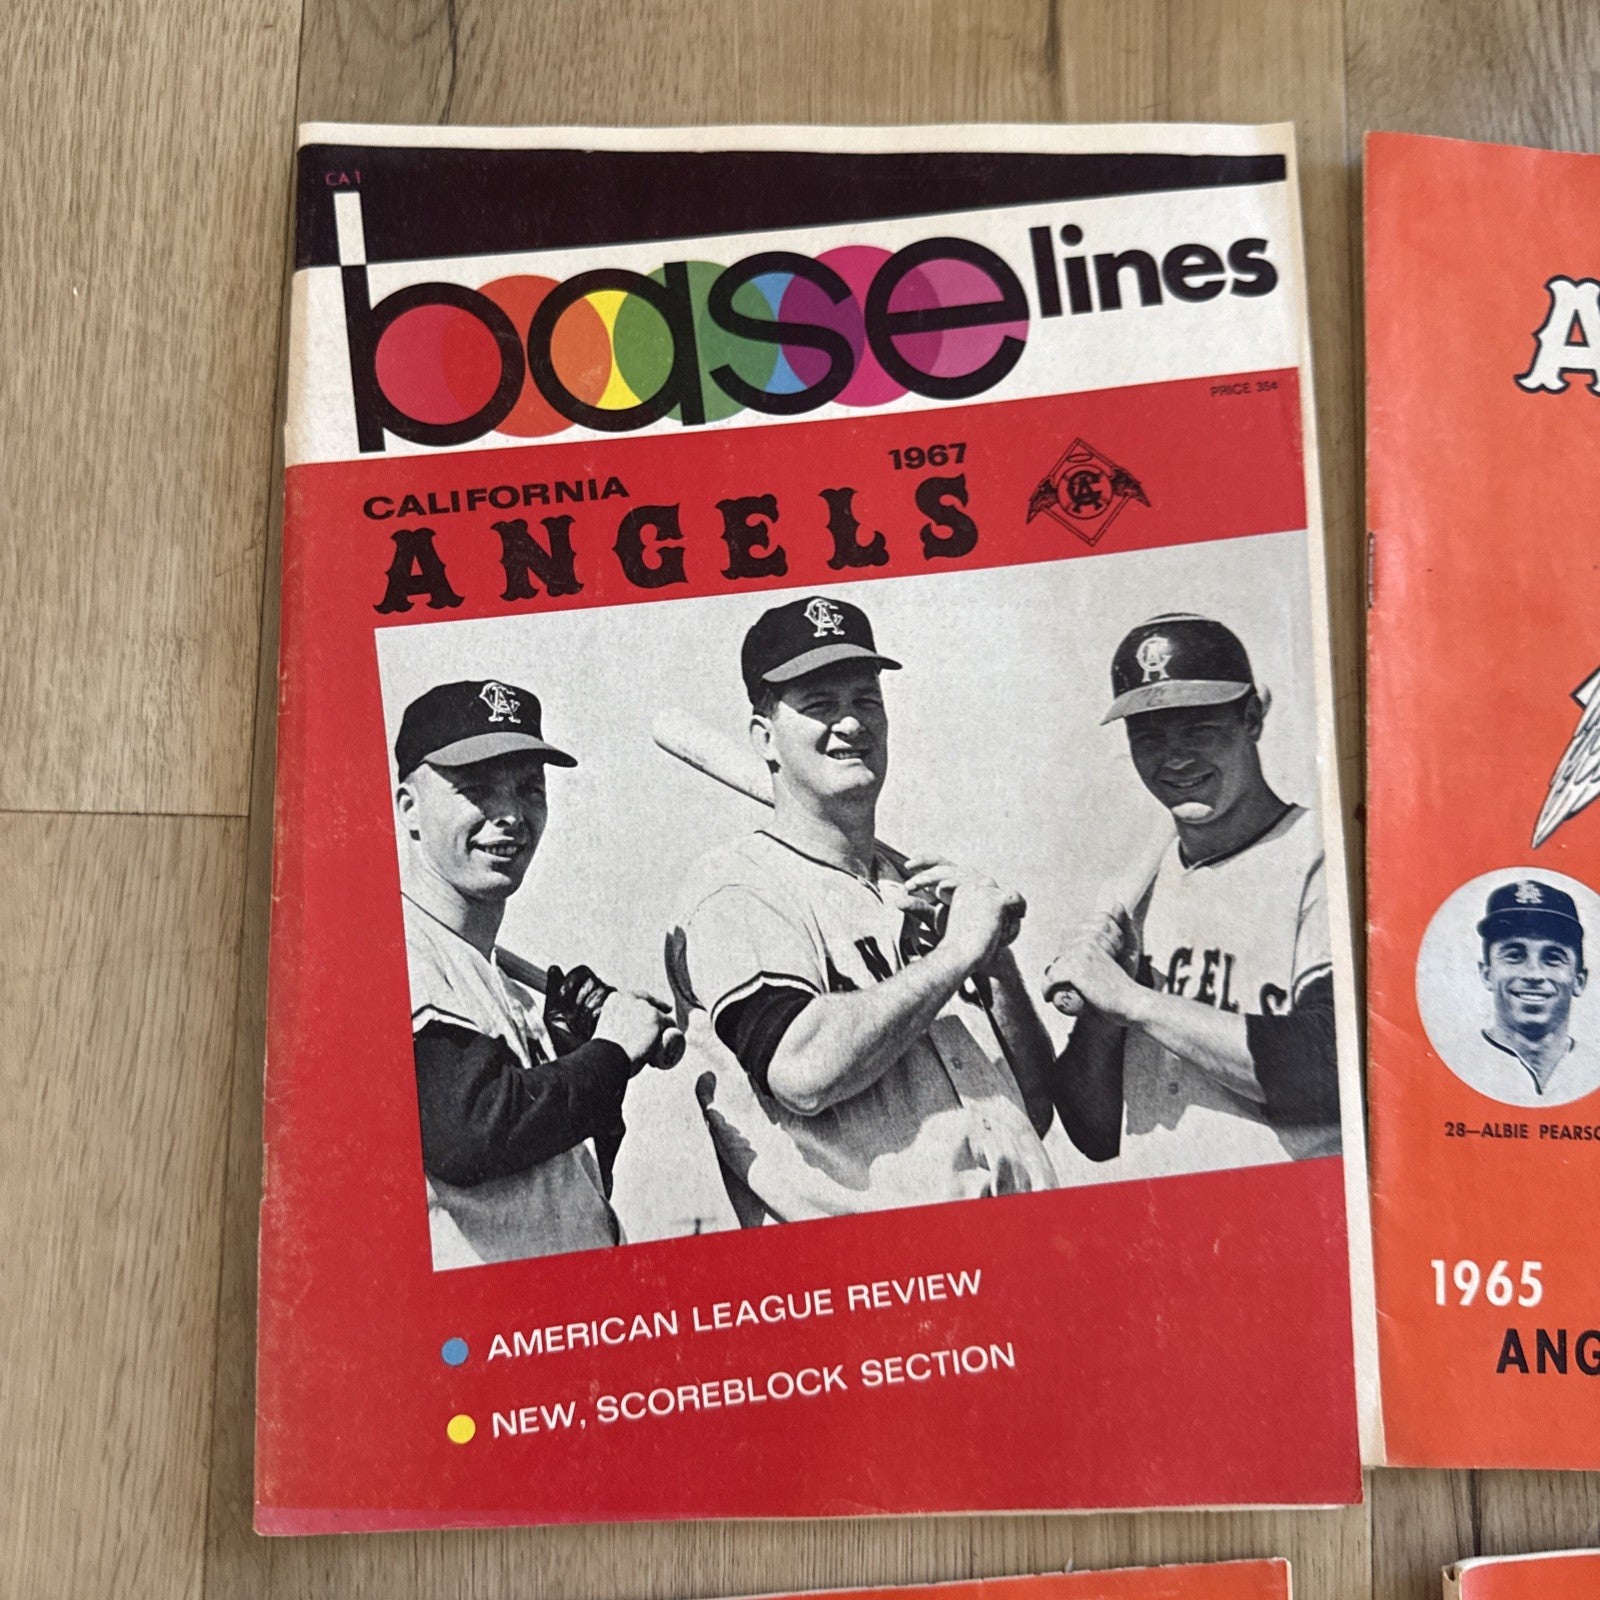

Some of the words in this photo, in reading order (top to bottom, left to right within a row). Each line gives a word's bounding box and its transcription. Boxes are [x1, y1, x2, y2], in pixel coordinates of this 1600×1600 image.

[324, 170, 350, 187] CA
[1027, 223, 1280, 320] lines
[1209, 382, 1251, 397] PRICE
[363, 475, 630, 521] CALIFORNIA
[888, 442, 968, 470] 1967
[372, 472, 980, 615] ANGELS
[486, 1308, 680, 1362] AMERICAN
[691, 1286, 835, 1334] LEAGUE
[845, 1268, 983, 1312] REVIEW
[1430, 1258, 1543, 1308] 1965
[490, 1400, 588, 1439] NEW,
[596, 1363, 848, 1425] SCOREBLOCK
[860, 1341, 1017, 1389] SECTION
